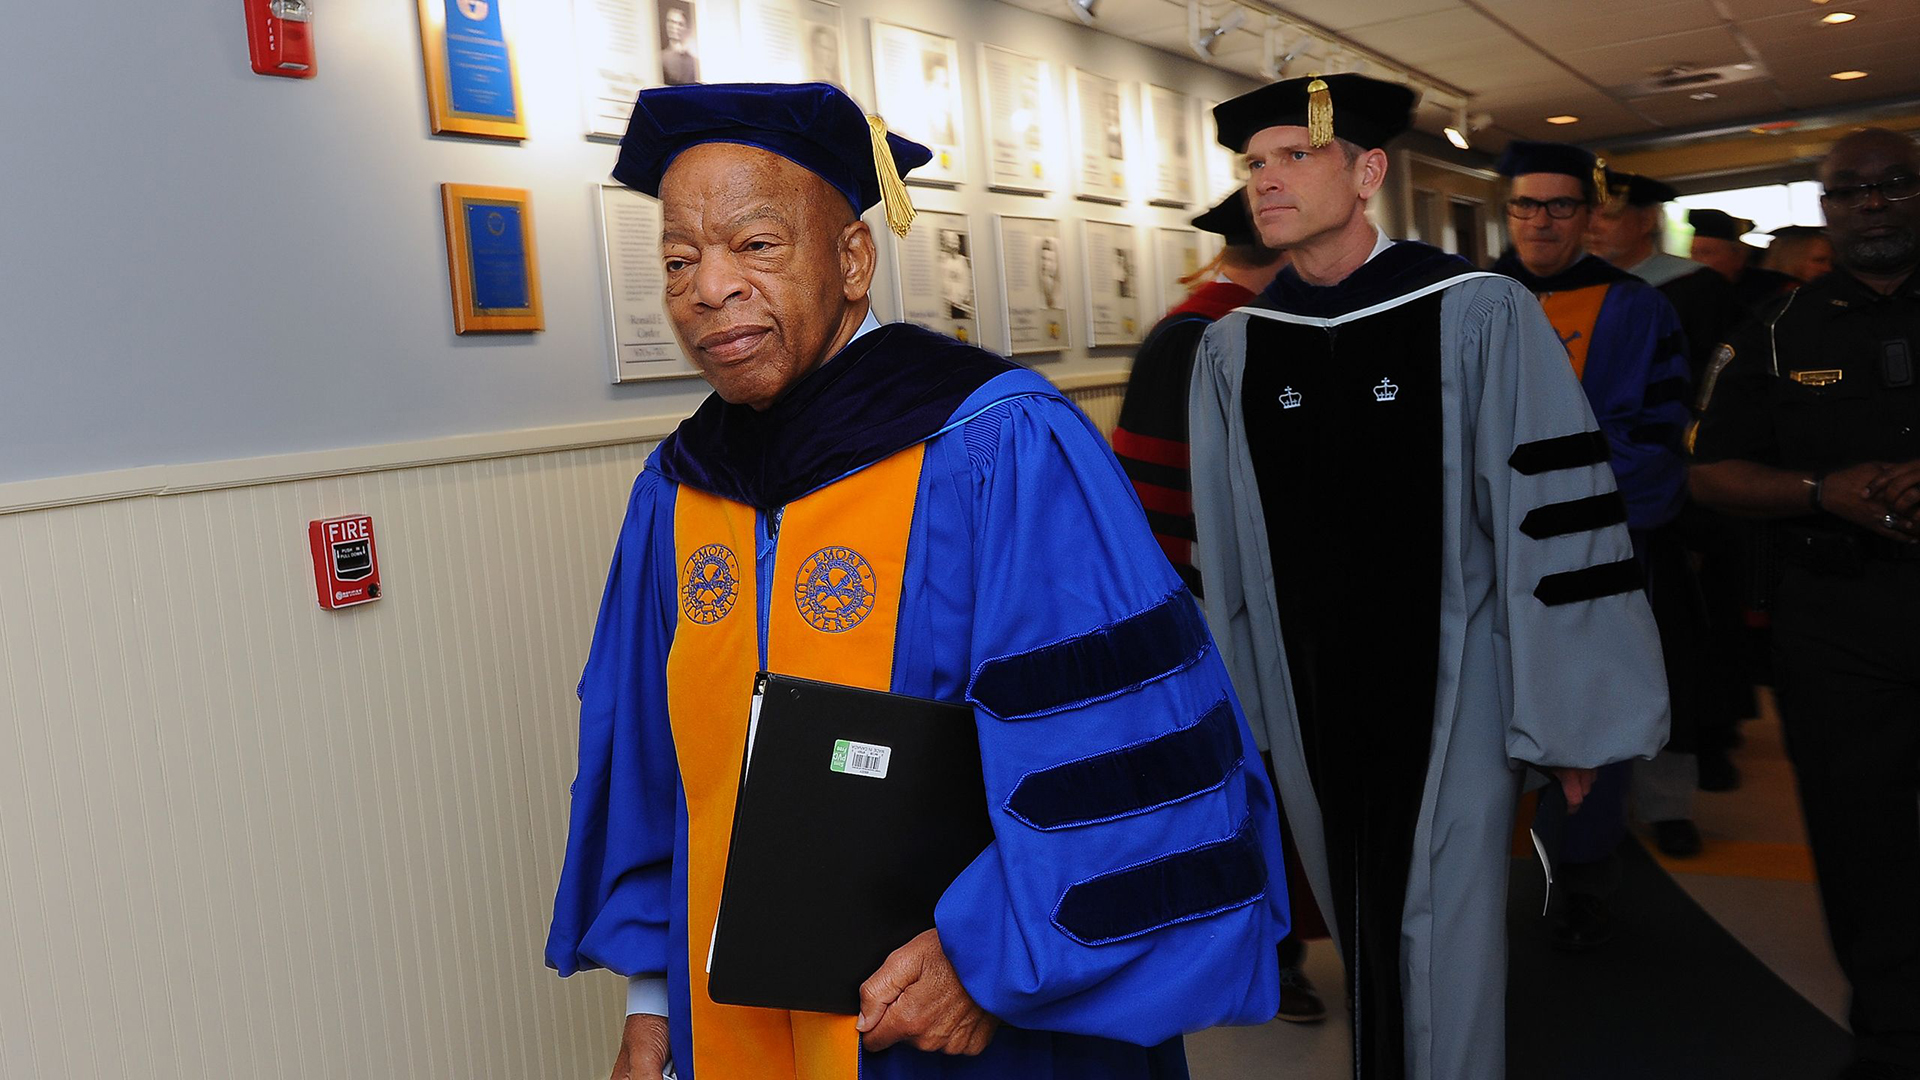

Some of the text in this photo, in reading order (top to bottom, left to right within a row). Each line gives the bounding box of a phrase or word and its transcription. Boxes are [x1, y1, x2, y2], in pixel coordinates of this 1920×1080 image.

[267, 18, 275, 51] FIRE
[329, 519, 369, 542] FIRE
[690, 545, 732, 565] EMORY
[812, 548, 865, 569] EMORY
[682, 579, 739, 623] UNIVERSITY
[795, 582, 876, 631] UNIVERSITY
[833, 752, 847, 762] PVC
